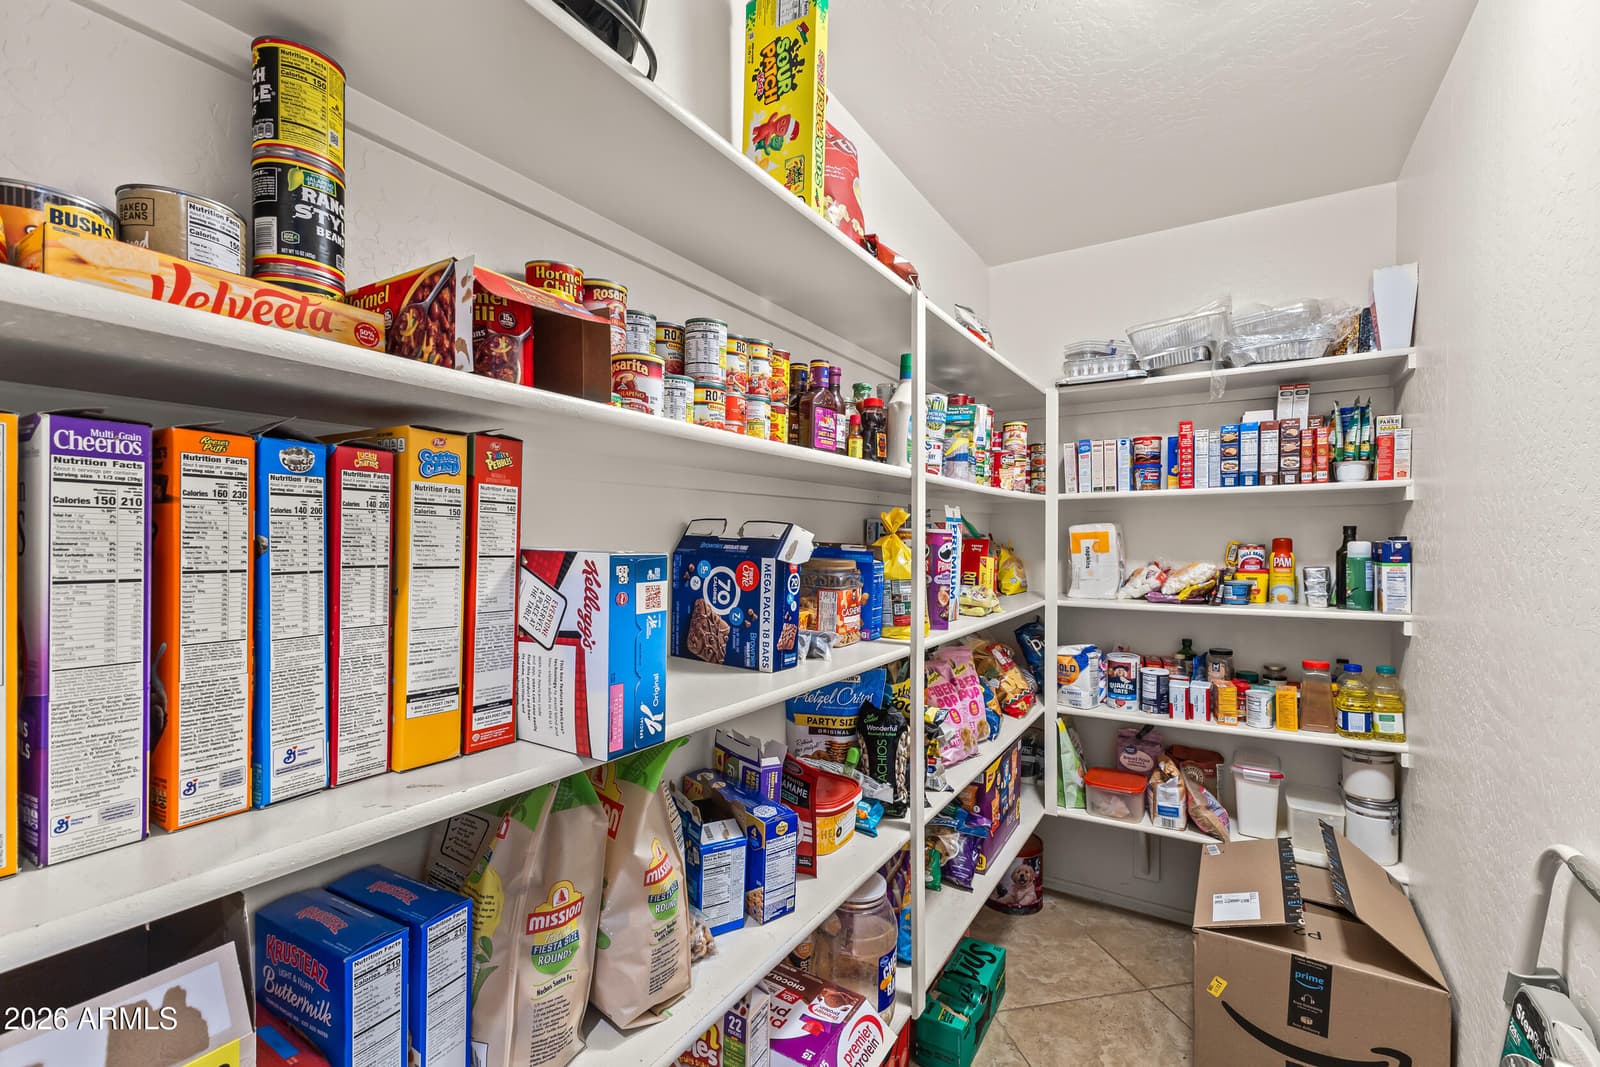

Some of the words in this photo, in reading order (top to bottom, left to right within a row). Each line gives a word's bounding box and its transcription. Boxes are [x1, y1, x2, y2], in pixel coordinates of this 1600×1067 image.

[281, 49, 309, 62] Nutrition
[311, 59, 327, 71] Facts
[776, 36, 794, 96] SOUR
[281, 69, 308, 82] Calories
[313, 78, 327, 90] 150
[762, 42, 780, 105] PATCH
[815, 84, 827, 134] PATCH
[815, 133, 826, 188] SOUR
[119, 202, 148, 212] BAKED
[119, 211, 148, 221] BEANS
[189, 203, 224, 220] Nutrition
[225, 214, 241, 229] Facts
[50, 207, 113, 239] BUSH'S
[189, 228, 220, 243] Calories
[535, 266, 582, 285] Hormel
[151, 263, 333, 333] Velveeta
[543, 279, 577, 297] Chili
[53, 428, 144, 456] Cheerios
[90, 428, 115, 439] Multi
[118, 431, 142, 442] Grain
[53, 456, 107, 467] Nutrition
[113, 461, 143, 470] Facts
[183, 454, 222, 463] Nutrition
[343, 470, 372, 479] Nutrition
[212, 490, 228, 498] 160
[232, 491, 247, 499] 230
[414, 484, 443, 493] Nutrition
[444, 486, 461, 495] Facts
[53, 496, 91, 505] Calories
[93, 496, 117, 506] 150
[121, 497, 143, 507] 210
[294, 506, 307, 514] 140
[310, 507, 323, 515] 200
[379, 501, 390, 509] 200
[449, 508, 461, 516] 150
[949, 524, 957, 600] PREMIUM
[1273, 557, 1292, 568] PAM
[763, 563, 772, 594] MEGA
[532, 585, 540, 597] THE
[718, 579, 731, 605] 70
[523, 597, 534, 622] TABLE
[533, 597, 543, 619] PLACE
[535, 594, 551, 632] DESERVES
[577, 559, 602, 652] Kellogg's
[762, 597, 771, 624] PACK
[542, 599, 558, 637] EVERYONE
[762, 629, 770, 638] 18
[761, 641, 770, 669] BARS
[837, 687, 874, 707] Crisps
[1110, 682, 1134, 691] QUAKER
[807, 717, 837, 726] PARTY
[839, 716, 858, 725] SIZE
[866, 724, 898, 732] Wonderful
[428, 915, 450, 933] Nutrition
[451, 909, 467, 922] Facts
[529, 902, 581, 931] mission
[428, 938, 450, 952] Calories
[453, 925, 467, 939] 210
[534, 941, 562, 954] FIESTA
[564, 934, 578, 945] SIZE
[266, 934, 329, 992] KRUSTEAZ
[354, 949, 383, 968] Nutrition
[384, 941, 402, 954] Facts
[537, 950, 572, 966] ROUNDS
[279, 968, 292, 980] LIGHT
[293, 975, 297, 983] &
[297, 978, 315, 994] FLUFFY
[354, 971, 381, 988] Calories
[385, 958, 401, 973] 210
[1295, 970, 1325, 985] prime
[536, 983, 552, 996] Nachos
[553, 977, 566, 986] Santa
[567, 973, 572, 981] Fe
[263, 965, 332, 1027] Buttermilk
[728, 1015, 742, 1033] 22
[843, 1024, 873, 1066] premier
[801, 1052, 814, 1061] 15
